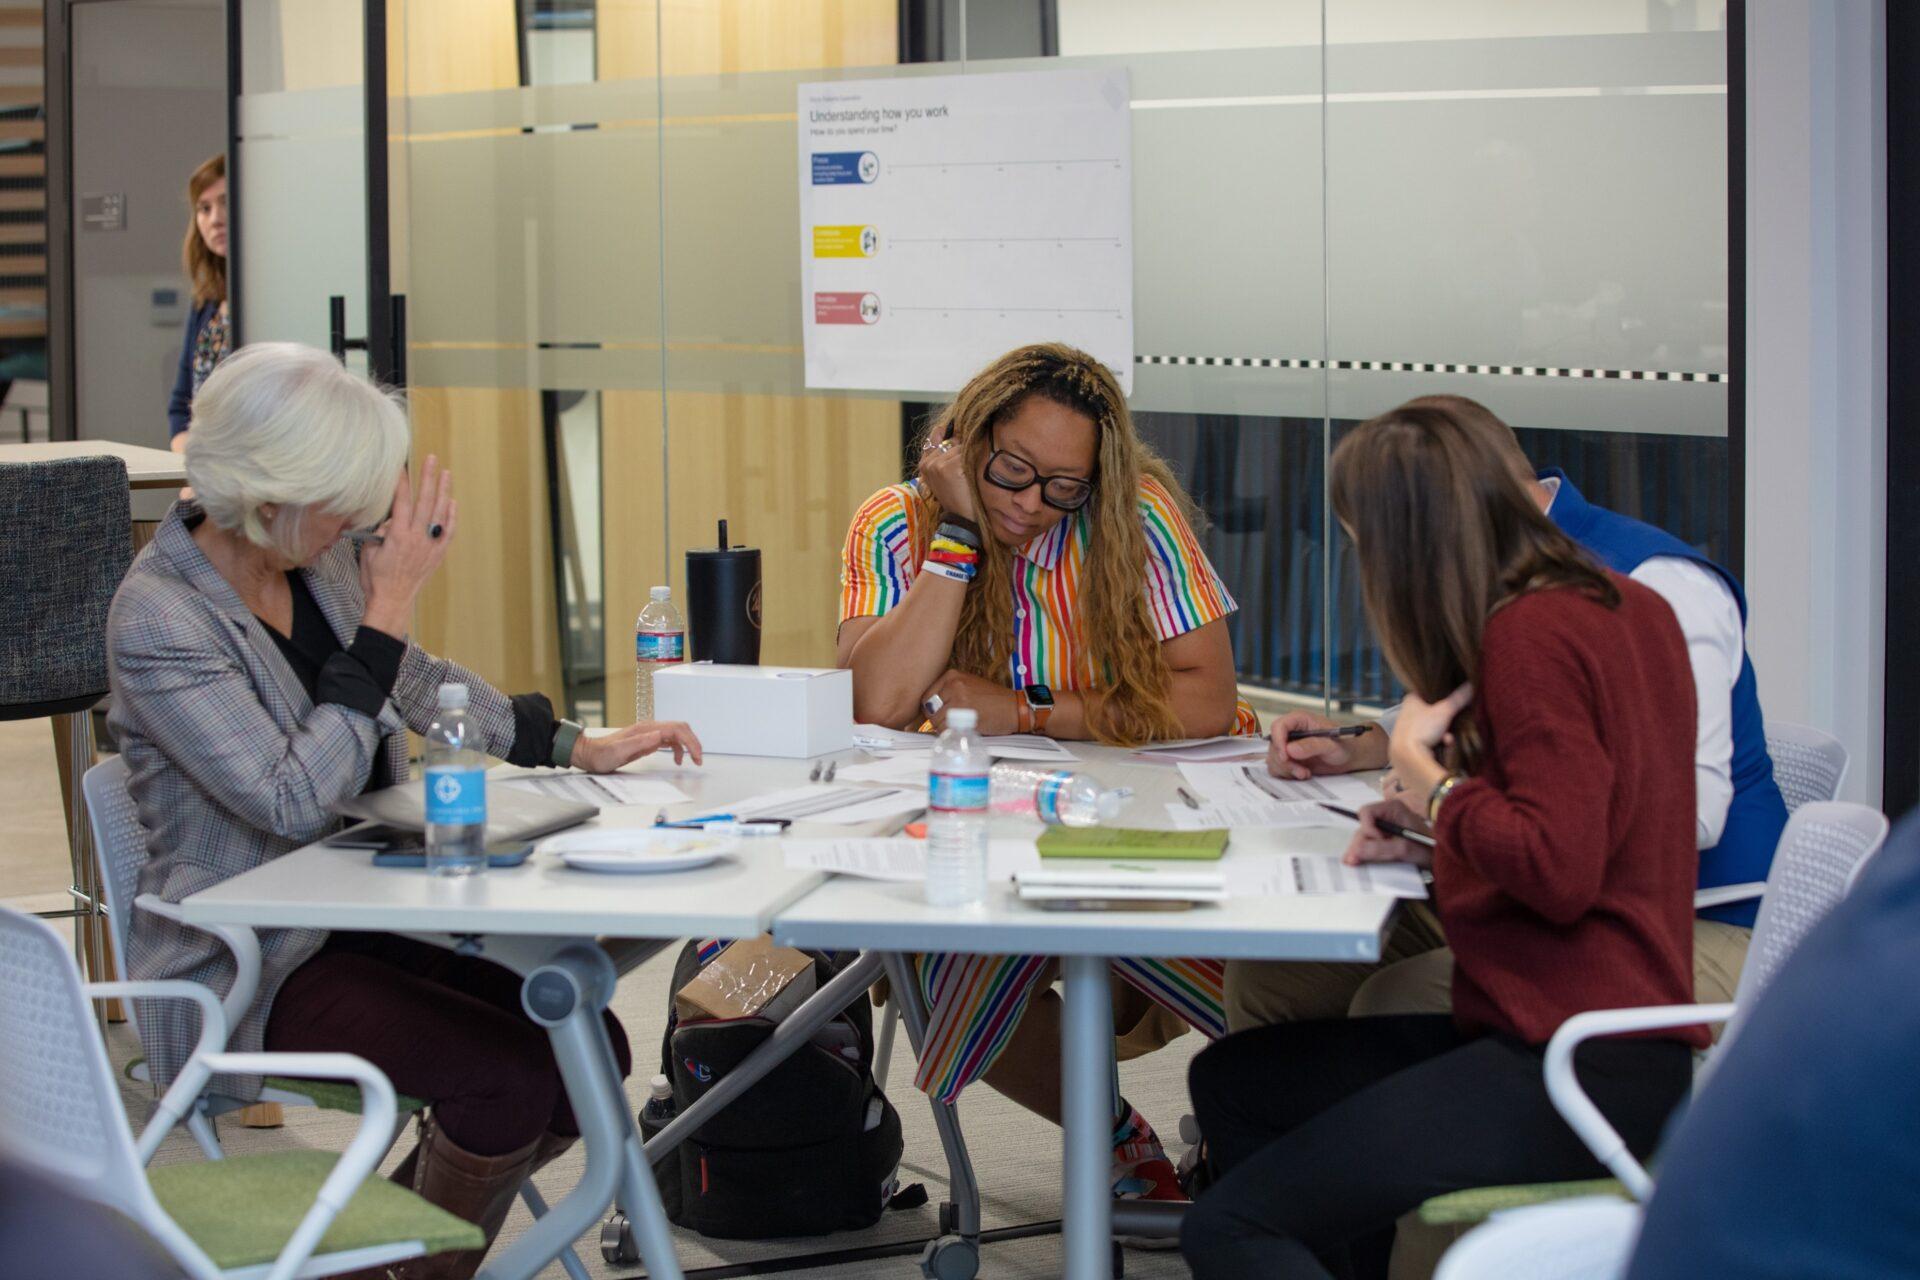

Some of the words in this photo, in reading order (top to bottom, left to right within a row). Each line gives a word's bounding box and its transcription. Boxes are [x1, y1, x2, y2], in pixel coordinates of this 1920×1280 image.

[810, 108, 880, 123] Understanding
[882, 108, 902, 119] how
[905, 108, 922, 122] you
[925, 105, 949, 118] work
[810, 127, 825, 136] How
[827, 127, 834, 136] do
[835, 127, 846, 138] you
[847, 125, 865, 138] spend
[866, 126, 879, 137] your
[881, 124, 898, 134] time?
